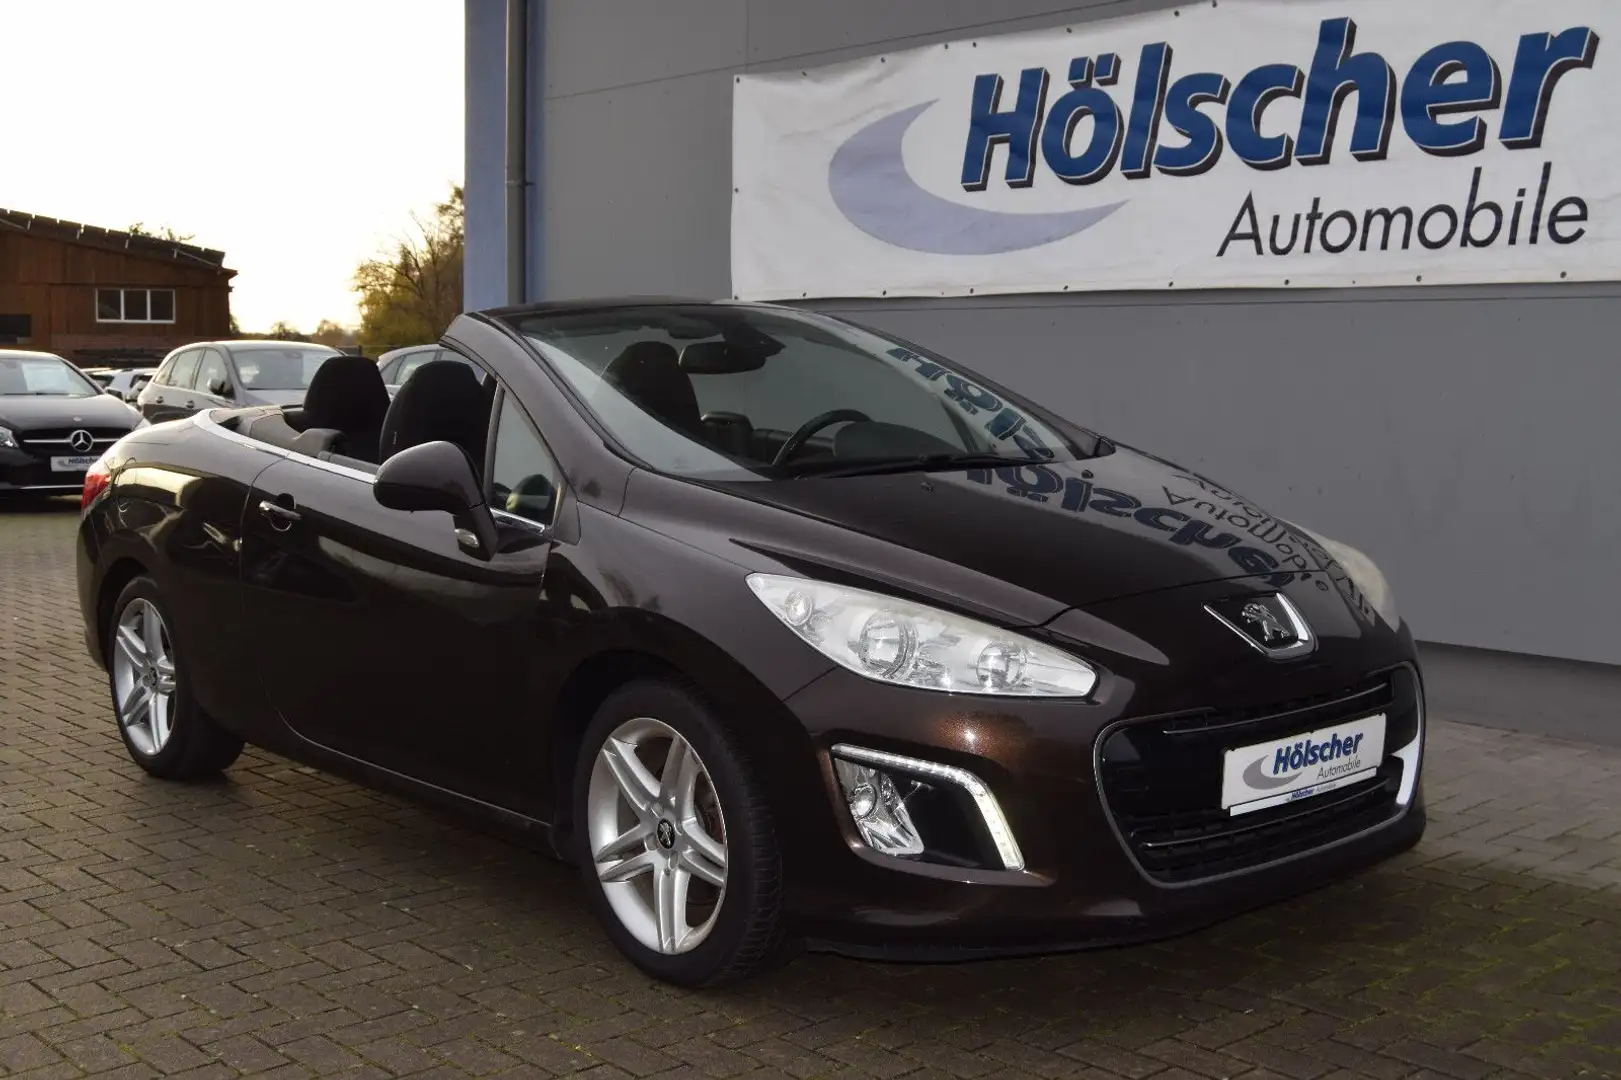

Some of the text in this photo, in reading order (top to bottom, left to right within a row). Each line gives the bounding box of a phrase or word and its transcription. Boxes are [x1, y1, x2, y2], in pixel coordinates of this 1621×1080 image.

[961, 17, 1600, 192] Hölscher
[1216, 161, 1589, 257] Automobile
[1272, 732, 1364, 775] Hölscher
[1316, 757, 1361, 780] Automobile
